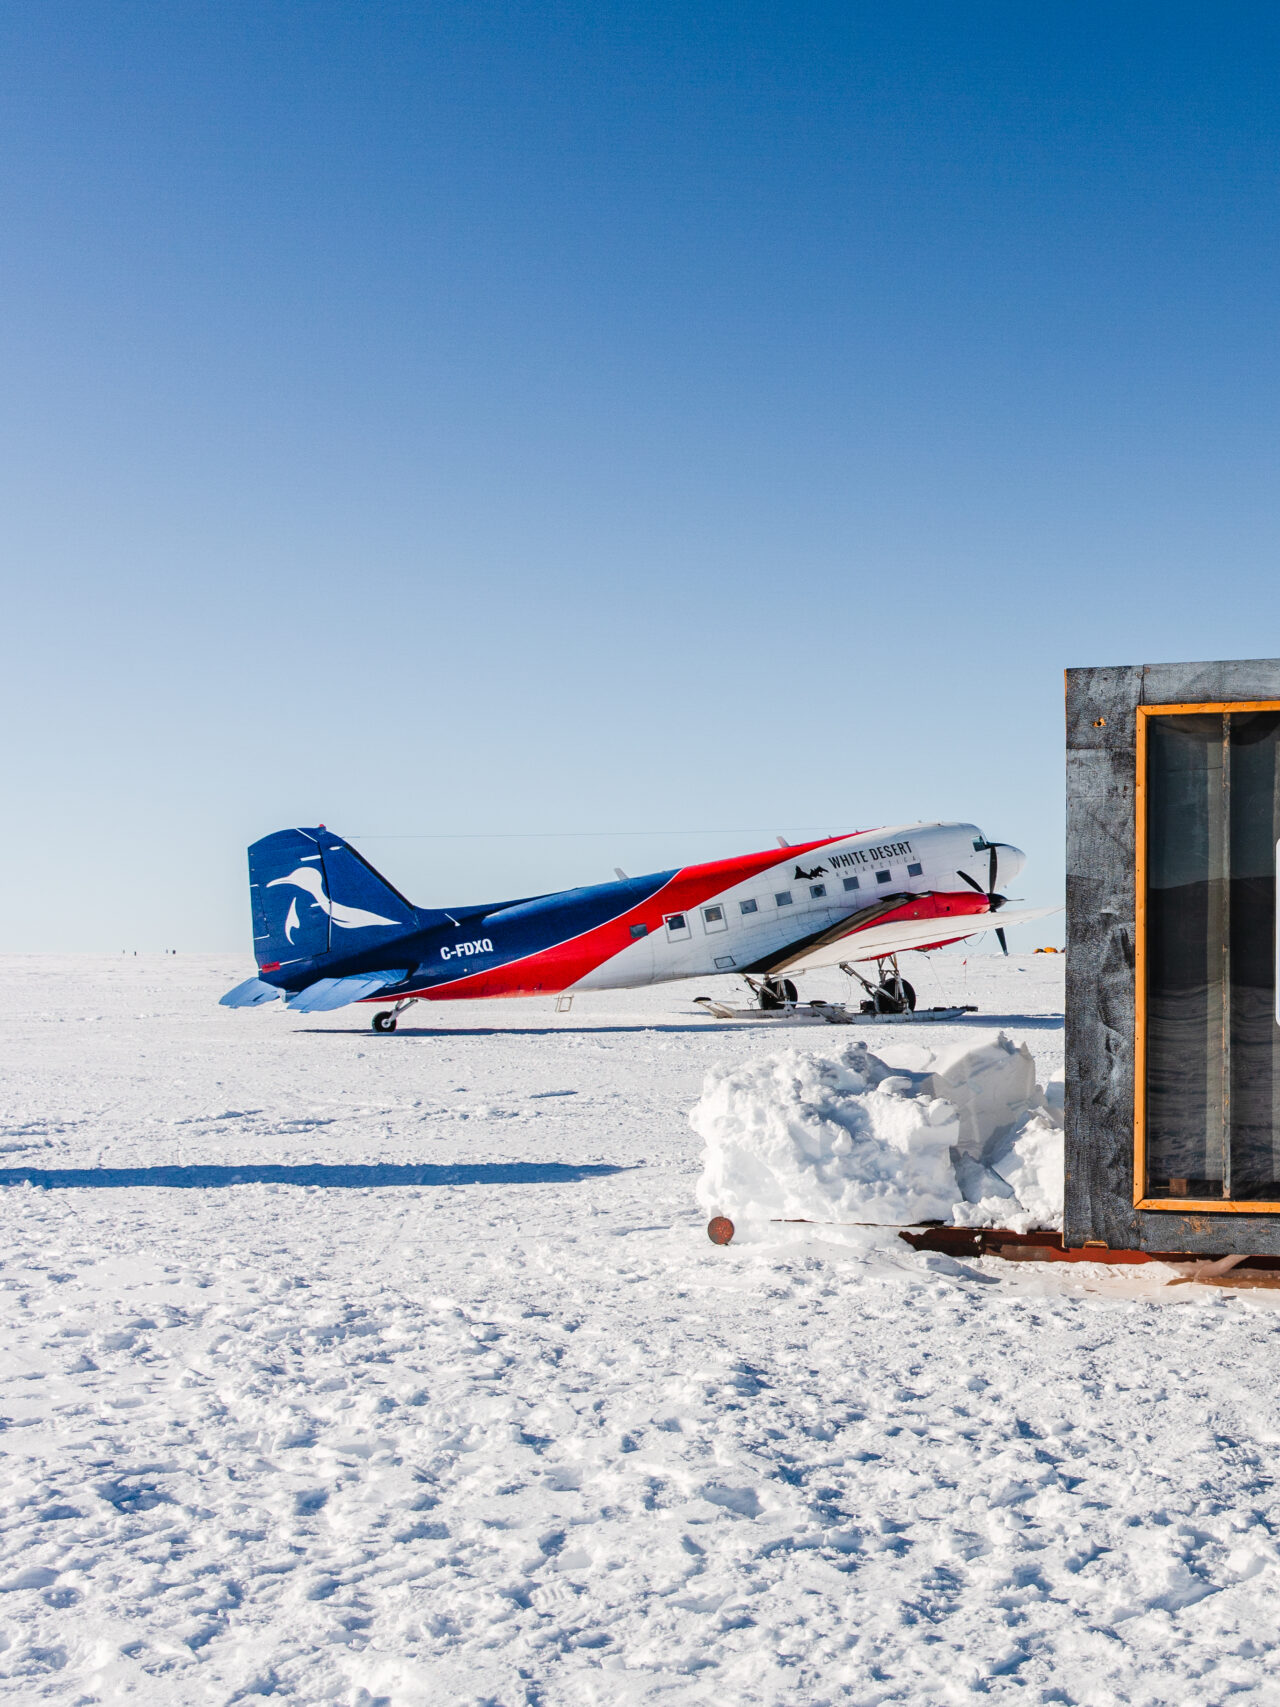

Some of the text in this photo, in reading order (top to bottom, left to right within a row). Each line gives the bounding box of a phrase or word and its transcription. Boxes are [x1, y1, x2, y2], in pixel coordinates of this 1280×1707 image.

[828, 841, 913, 869] WHITE DESERT
[440, 938, 494, 960] C-FDXQ
